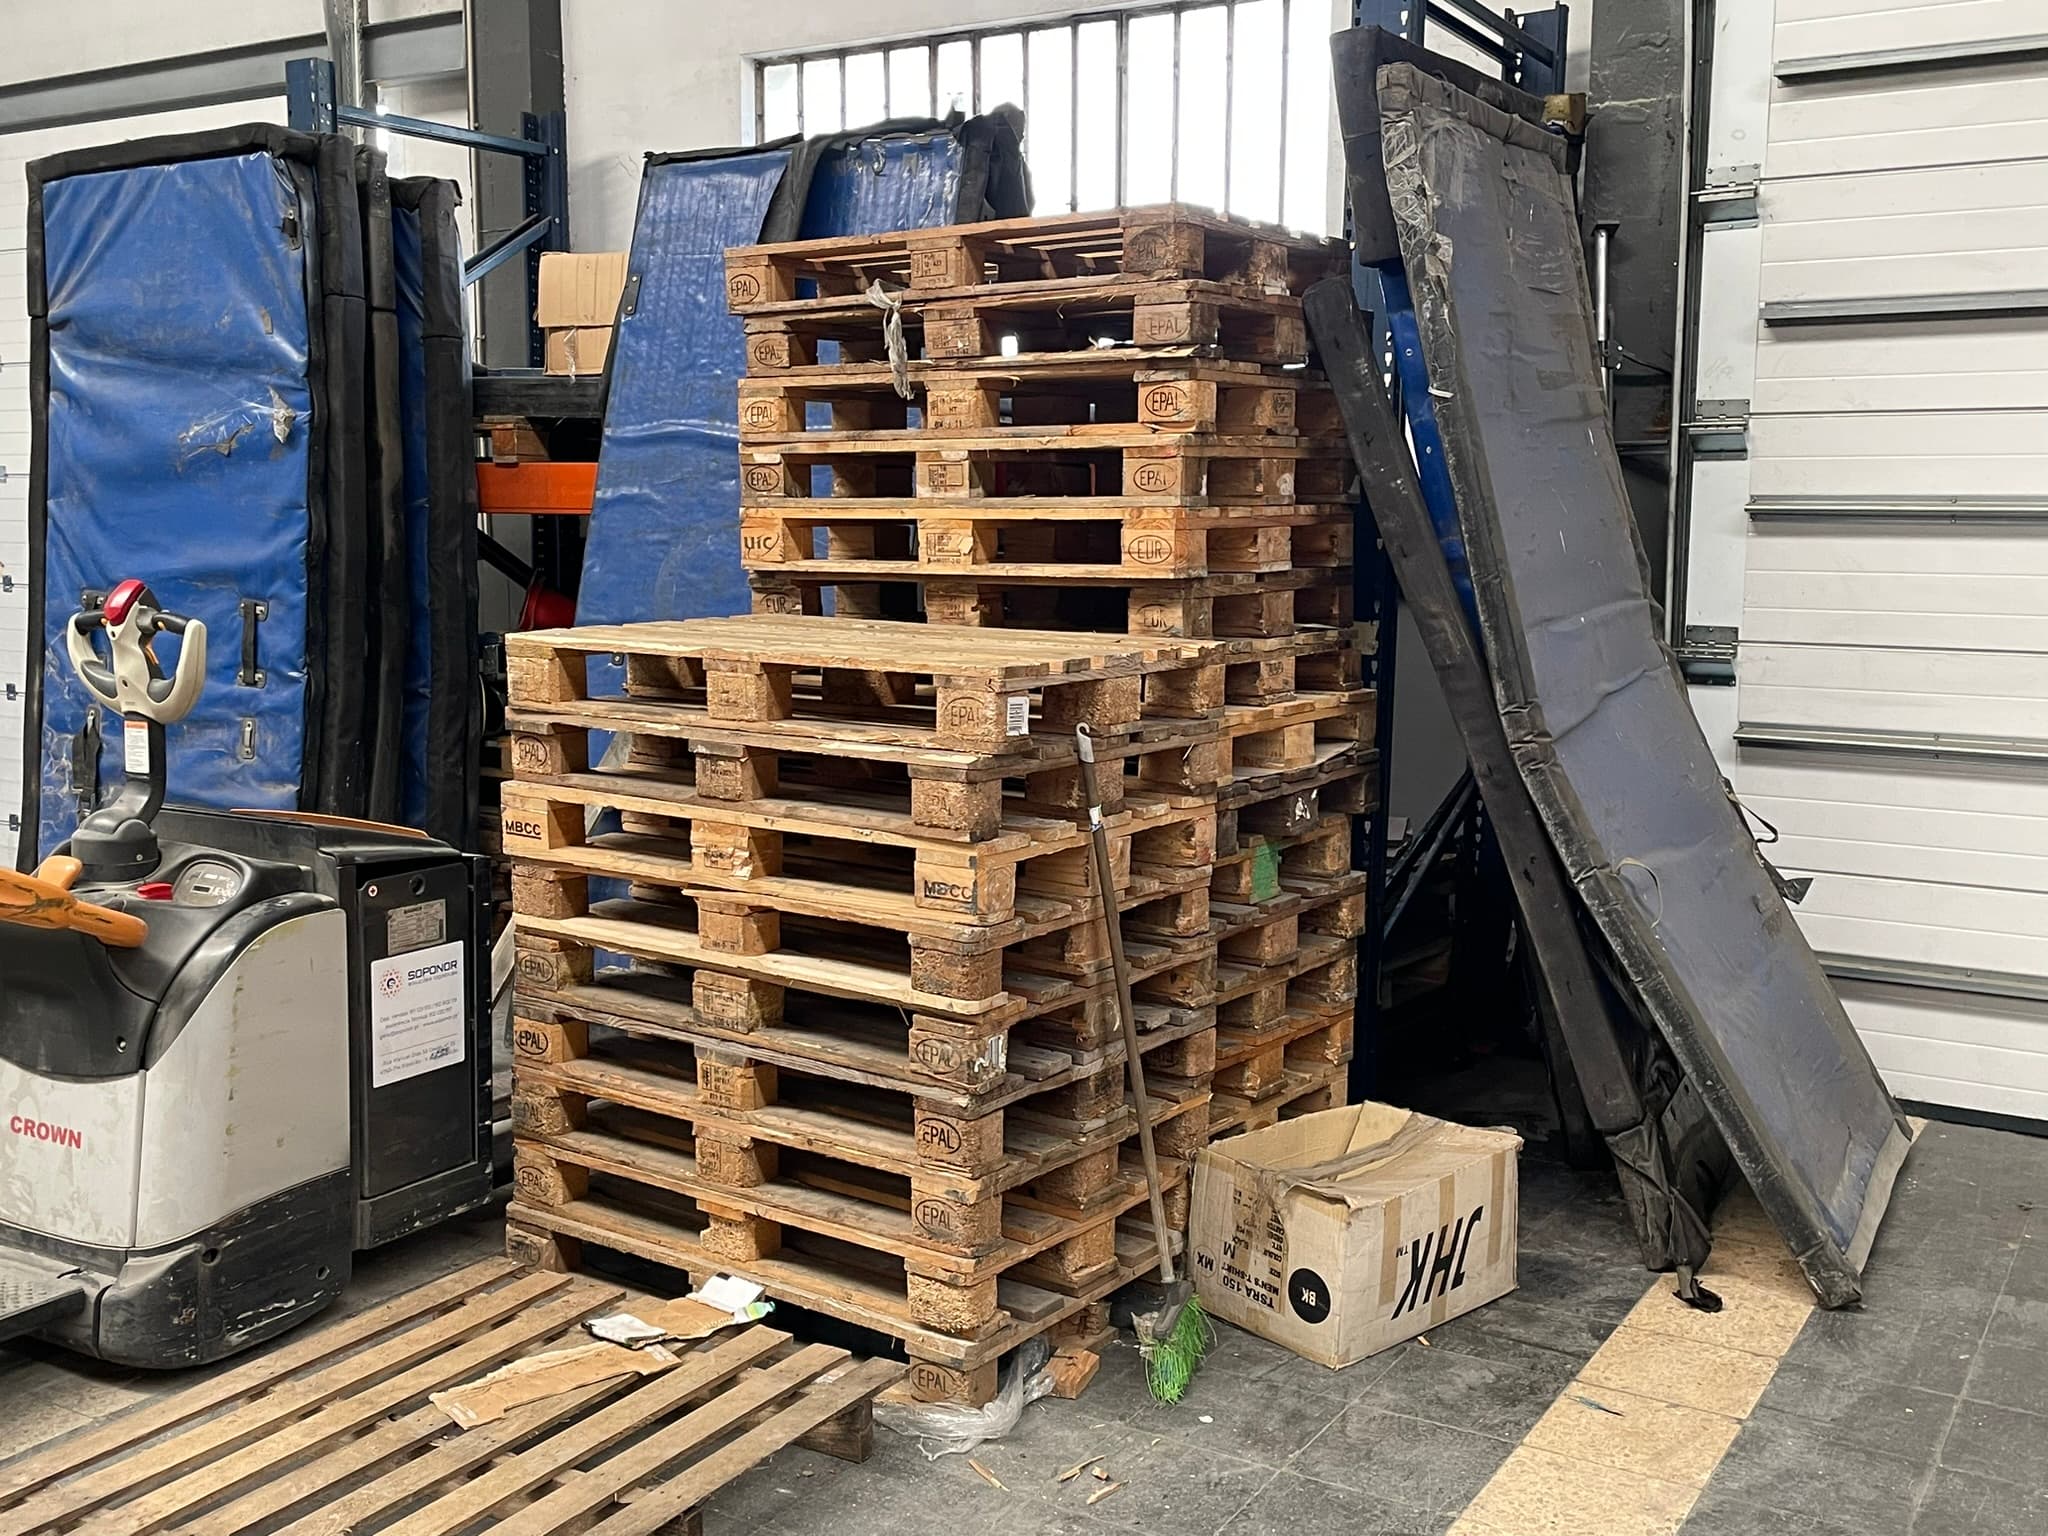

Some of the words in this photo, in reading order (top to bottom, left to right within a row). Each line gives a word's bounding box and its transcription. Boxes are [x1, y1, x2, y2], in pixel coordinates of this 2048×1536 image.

[730, 279, 754, 297] EPAL
[1150, 319, 1182, 337] EPAL
[758, 346, 782, 361] EPAL
[1151, 390, 1180, 412] EPAL
[750, 406, 774, 424] EPAL
[1137, 540, 1162, 560] EUR
[766, 598, 787, 614] EUR
[518, 741, 543, 764] EPAL
[505, 820, 542, 836] MBCC
[407, 959, 458, 981] SOPONOR
[518, 1030, 544, 1051] EPAL
[922, 1044, 954, 1068] EPAL
[10, 1115, 82, 1149] CROWN
[922, 1124, 955, 1152] EPAL
[1223, 1241, 1236, 1260] M
[1196, 1251, 1214, 1272] MX
[1391, 1205, 1484, 1321] JHK
[1222, 1275, 1242, 1293] 150
[1244, 1285, 1275, 1309] TSRA
[1301, 1287, 1317, 1307] BK
